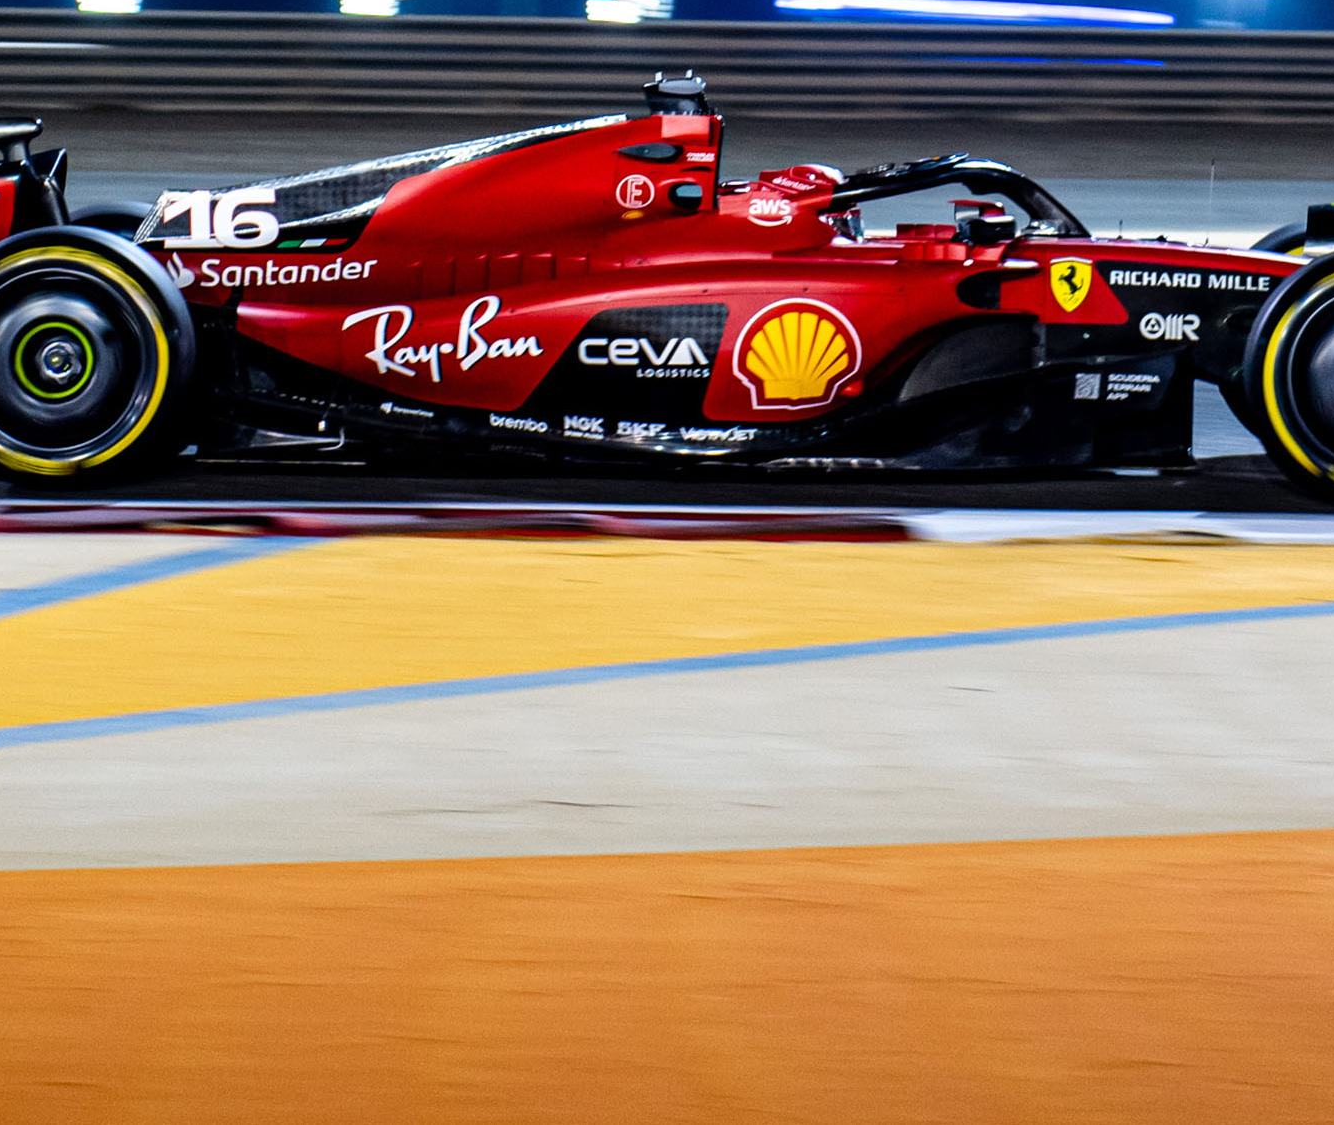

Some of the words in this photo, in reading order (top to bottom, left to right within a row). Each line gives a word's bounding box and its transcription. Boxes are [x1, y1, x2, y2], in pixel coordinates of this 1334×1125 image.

[749, 198, 791, 215] aws
[163, 188, 280, 249] 16
[199, 257, 378, 288] Santander
[1109, 270, 1202, 288] RICHARD
[1208, 274, 1271, 291] MILLE
[636, 368, 711, 378] LOGISTICS
[489, 412, 549, 433] brembo
[563, 415, 605, 432] NGK
